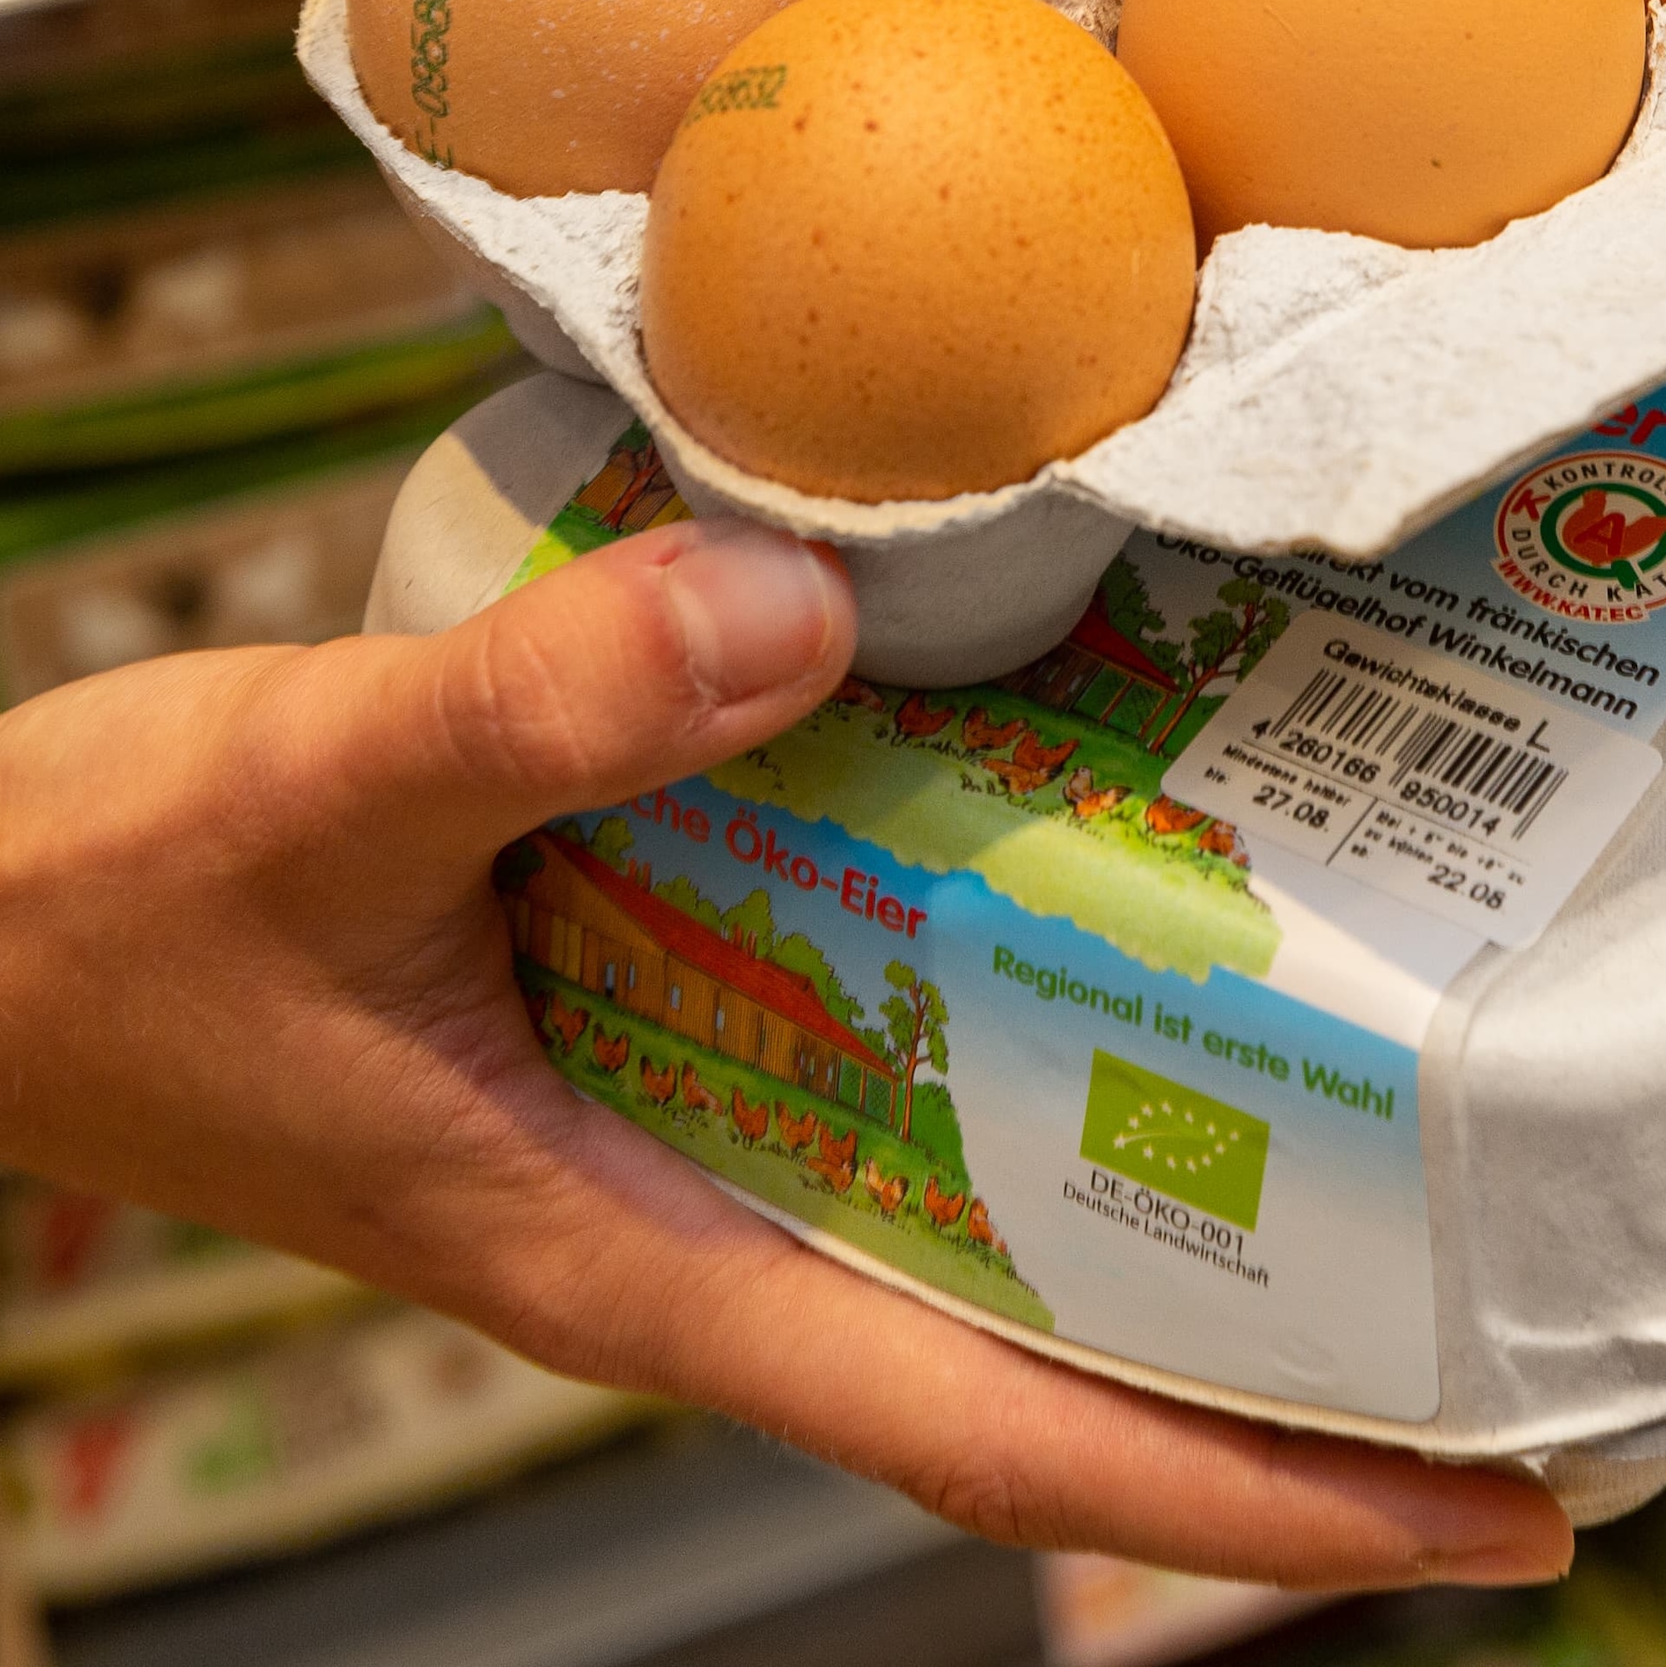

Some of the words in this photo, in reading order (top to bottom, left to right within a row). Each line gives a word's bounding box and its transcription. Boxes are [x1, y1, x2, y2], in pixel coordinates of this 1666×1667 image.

[1511, 527, 1588, 597] DURCH
[1388, 574, 1461, 609] vom
[1465, 596, 1660, 686] fränkischen
[1429, 621, 1638, 720] Winkelmann
[1323, 640, 1522, 733] Gewichtsklasse
[1526, 718, 1552, 754] L
[1249, 717, 1271, 741] 4
[1280, 730, 1382, 785] 260166
[1399, 780, 1502, 836] 950014
[725, 806, 927, 939] Öko-Eier
[992, 945, 1145, 1027] Regional
[1152, 1004, 1194, 1045] ist
[1202, 1029, 1291, 1082] erste
[1299, 1059, 1396, 1121] Wahl
[1063, 1181, 1140, 1230] Deutsche
[1144, 1218, 1269, 1287] Landwirtschaft
[1090, 1170, 1245, 1255] DE-ÖKO-001
